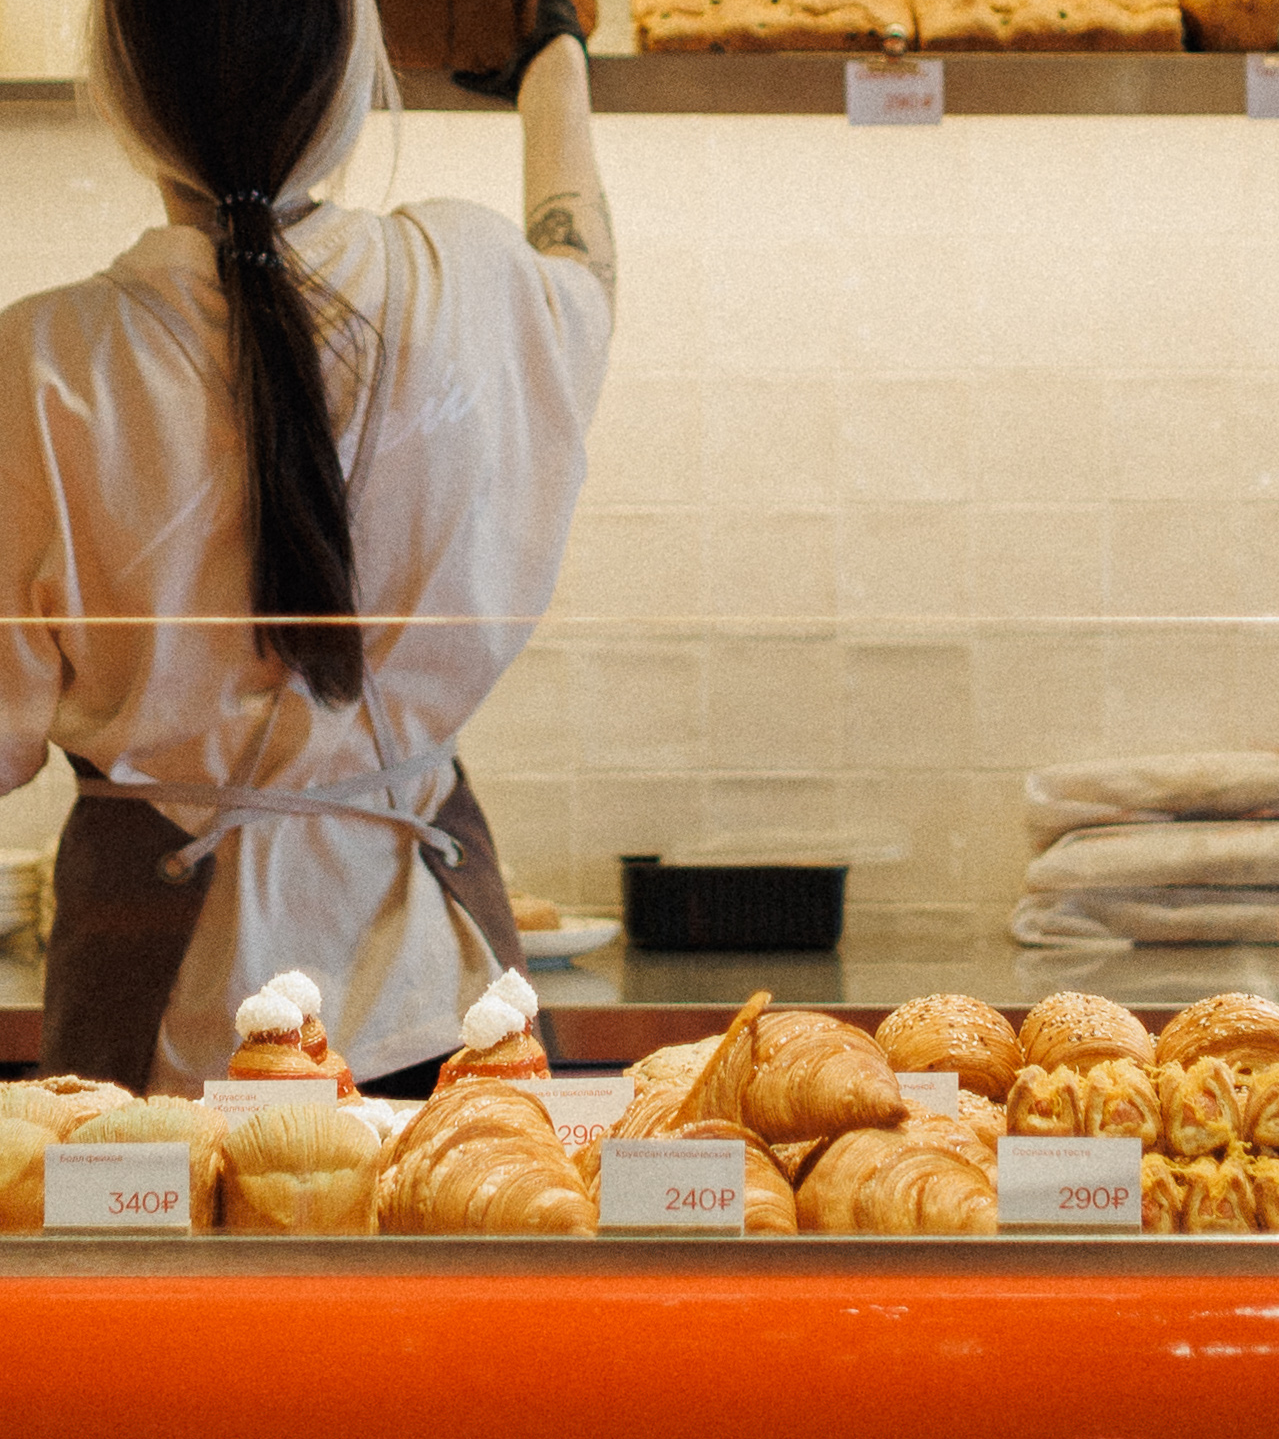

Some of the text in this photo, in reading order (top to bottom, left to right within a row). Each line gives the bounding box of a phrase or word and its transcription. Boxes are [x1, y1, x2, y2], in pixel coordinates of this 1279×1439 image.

[212, 1092, 257, 1102] Круассан
[557, 1123, 605, 1146] 290
[615, 1149, 662, 1159] Круассан
[107, 1190, 180, 1215] 340₽
[664, 1187, 737, 1211] 240₽
[1058, 1186, 1130, 1210] 290₽
